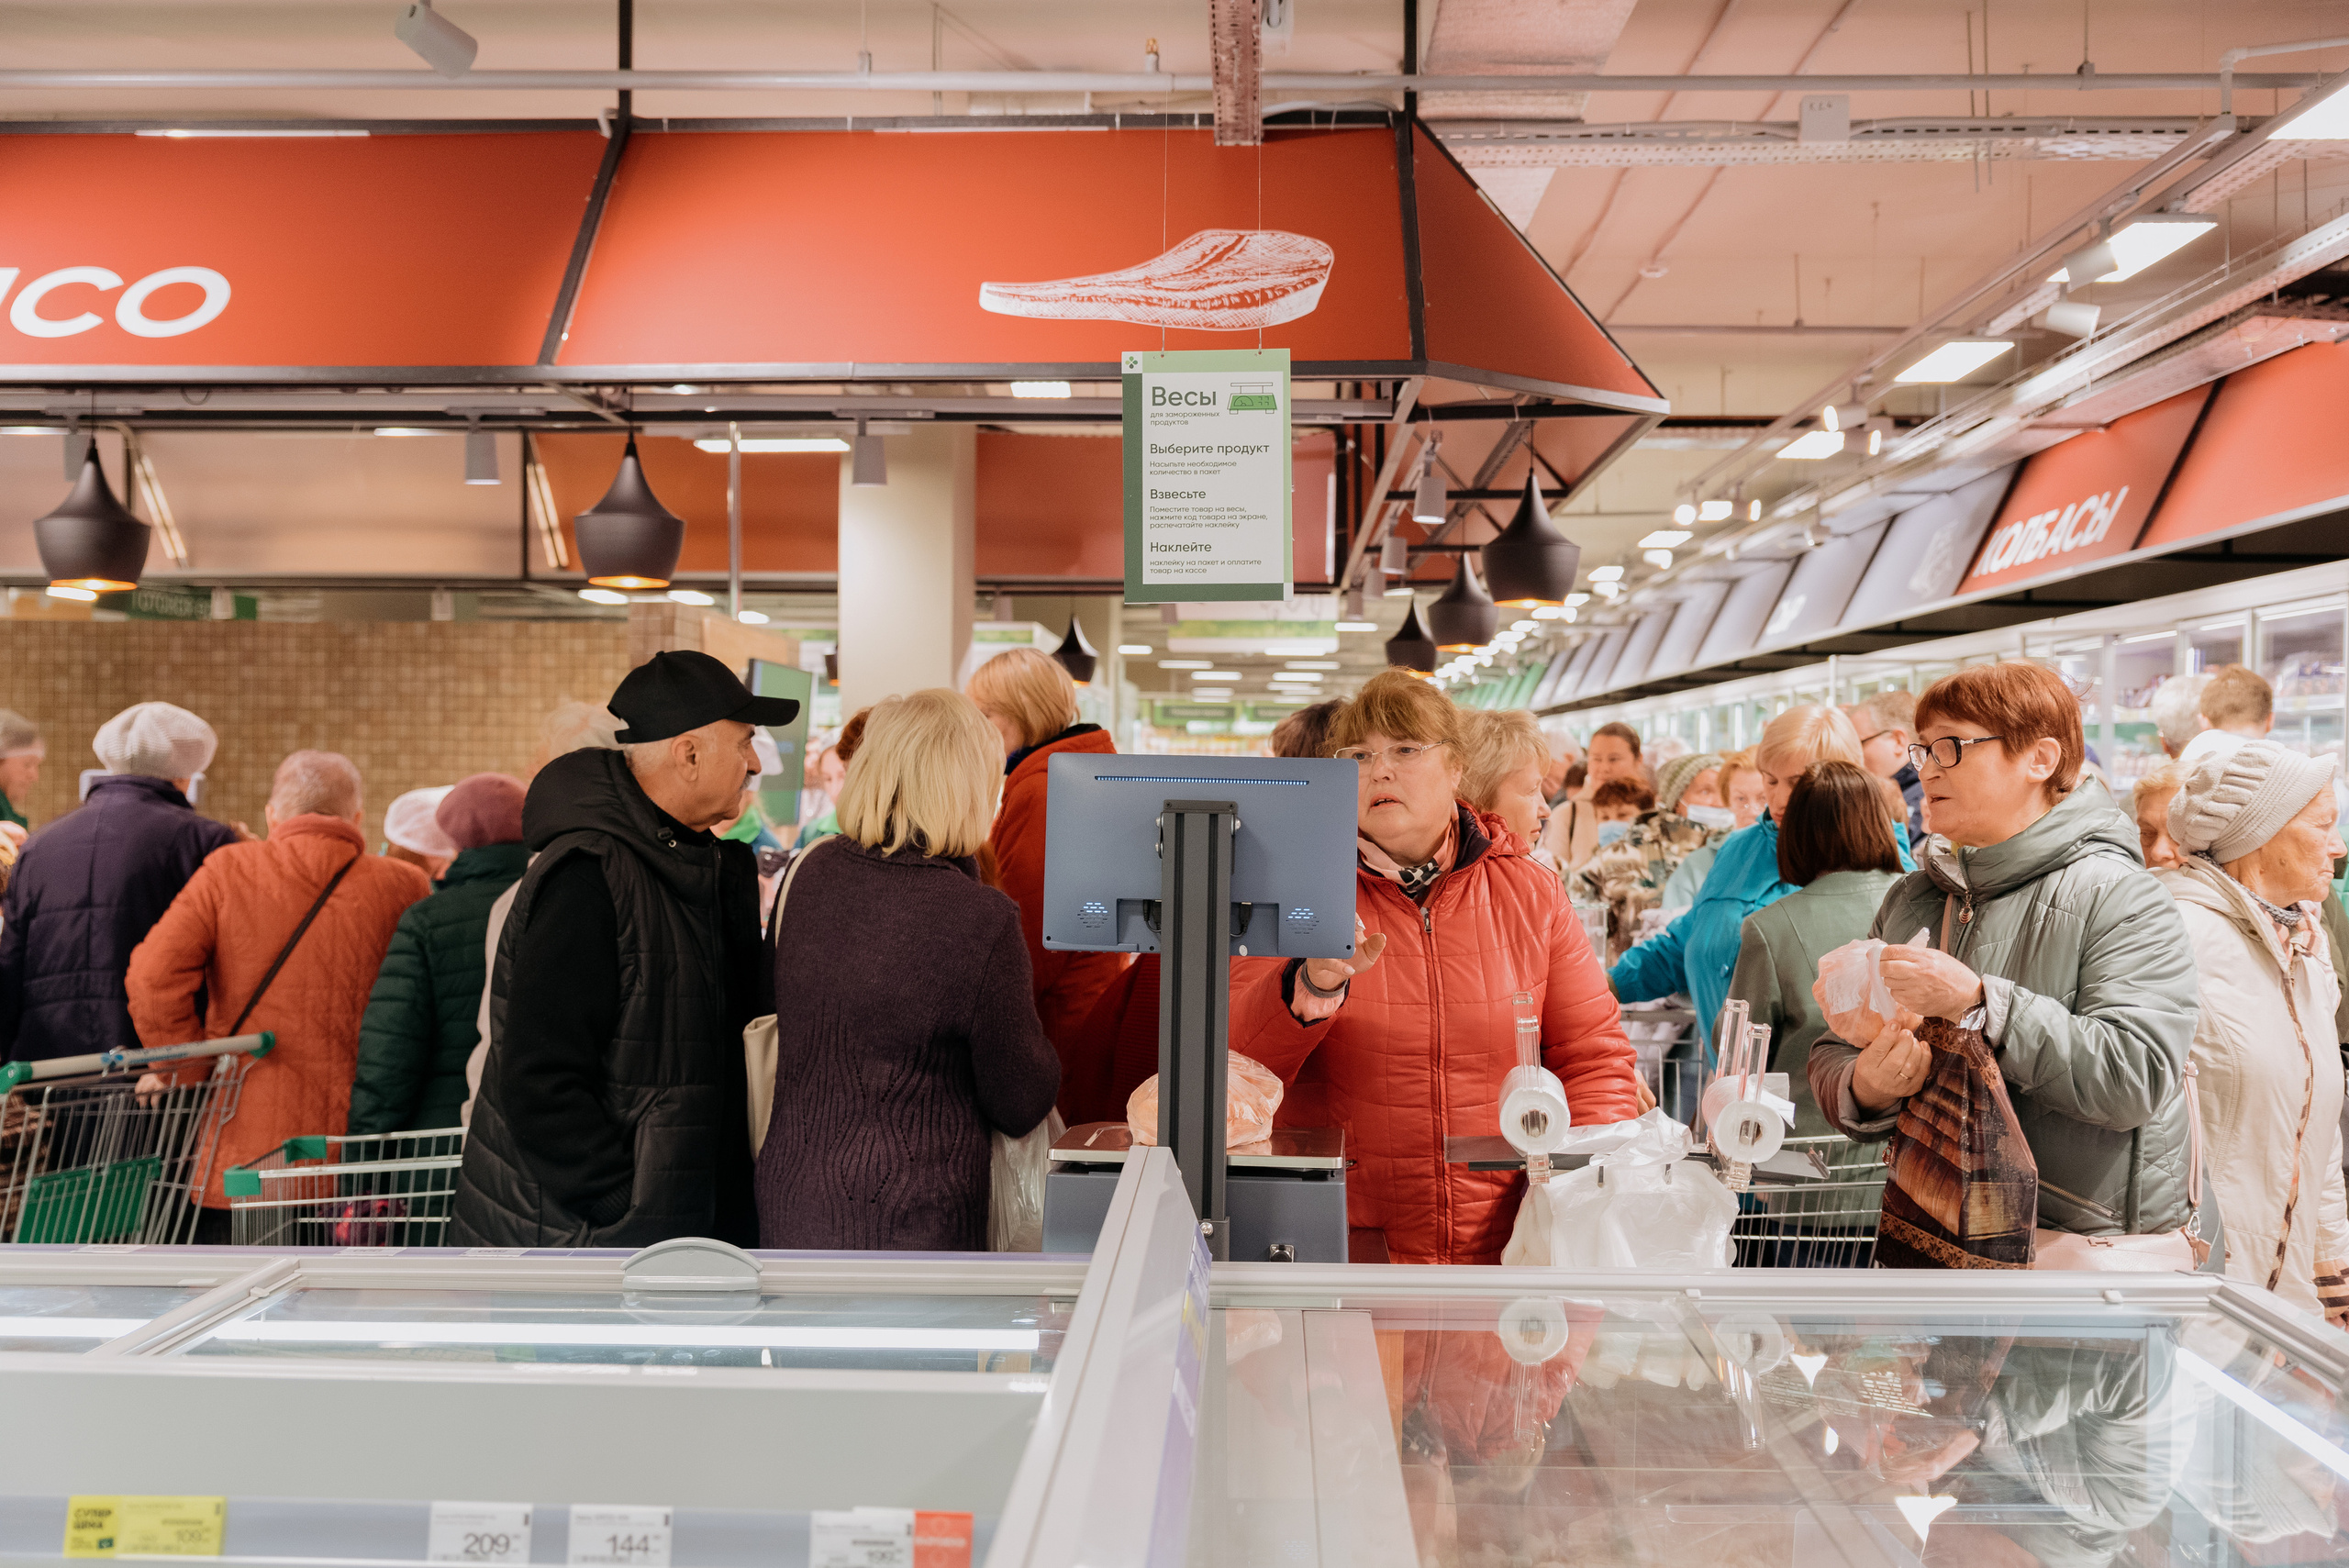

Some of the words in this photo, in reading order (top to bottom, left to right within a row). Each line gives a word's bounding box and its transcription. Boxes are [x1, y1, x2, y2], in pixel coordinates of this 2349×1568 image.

[0, 266, 231, 338] СО
[1152, 385, 1217, 406] Весы
[1150, 412, 1163, 420] для
[1164, 412, 1220, 420] замороженных
[1150, 443, 1214, 457] Выберите
[1217, 444, 1270, 457] продукт
[1150, 488, 1207, 500] Взвесьте
[1150, 521, 1203, 529] распечатайте
[1204, 521, 1240, 529] наклейку
[1973, 486, 2129, 577] КОЛБАСЫ
[1150, 541, 1212, 553] Наклейте
[1150, 559, 1185, 567] наклейку
[462, 1532, 510, 1556] 209
[606, 1533, 650, 1556] 144
